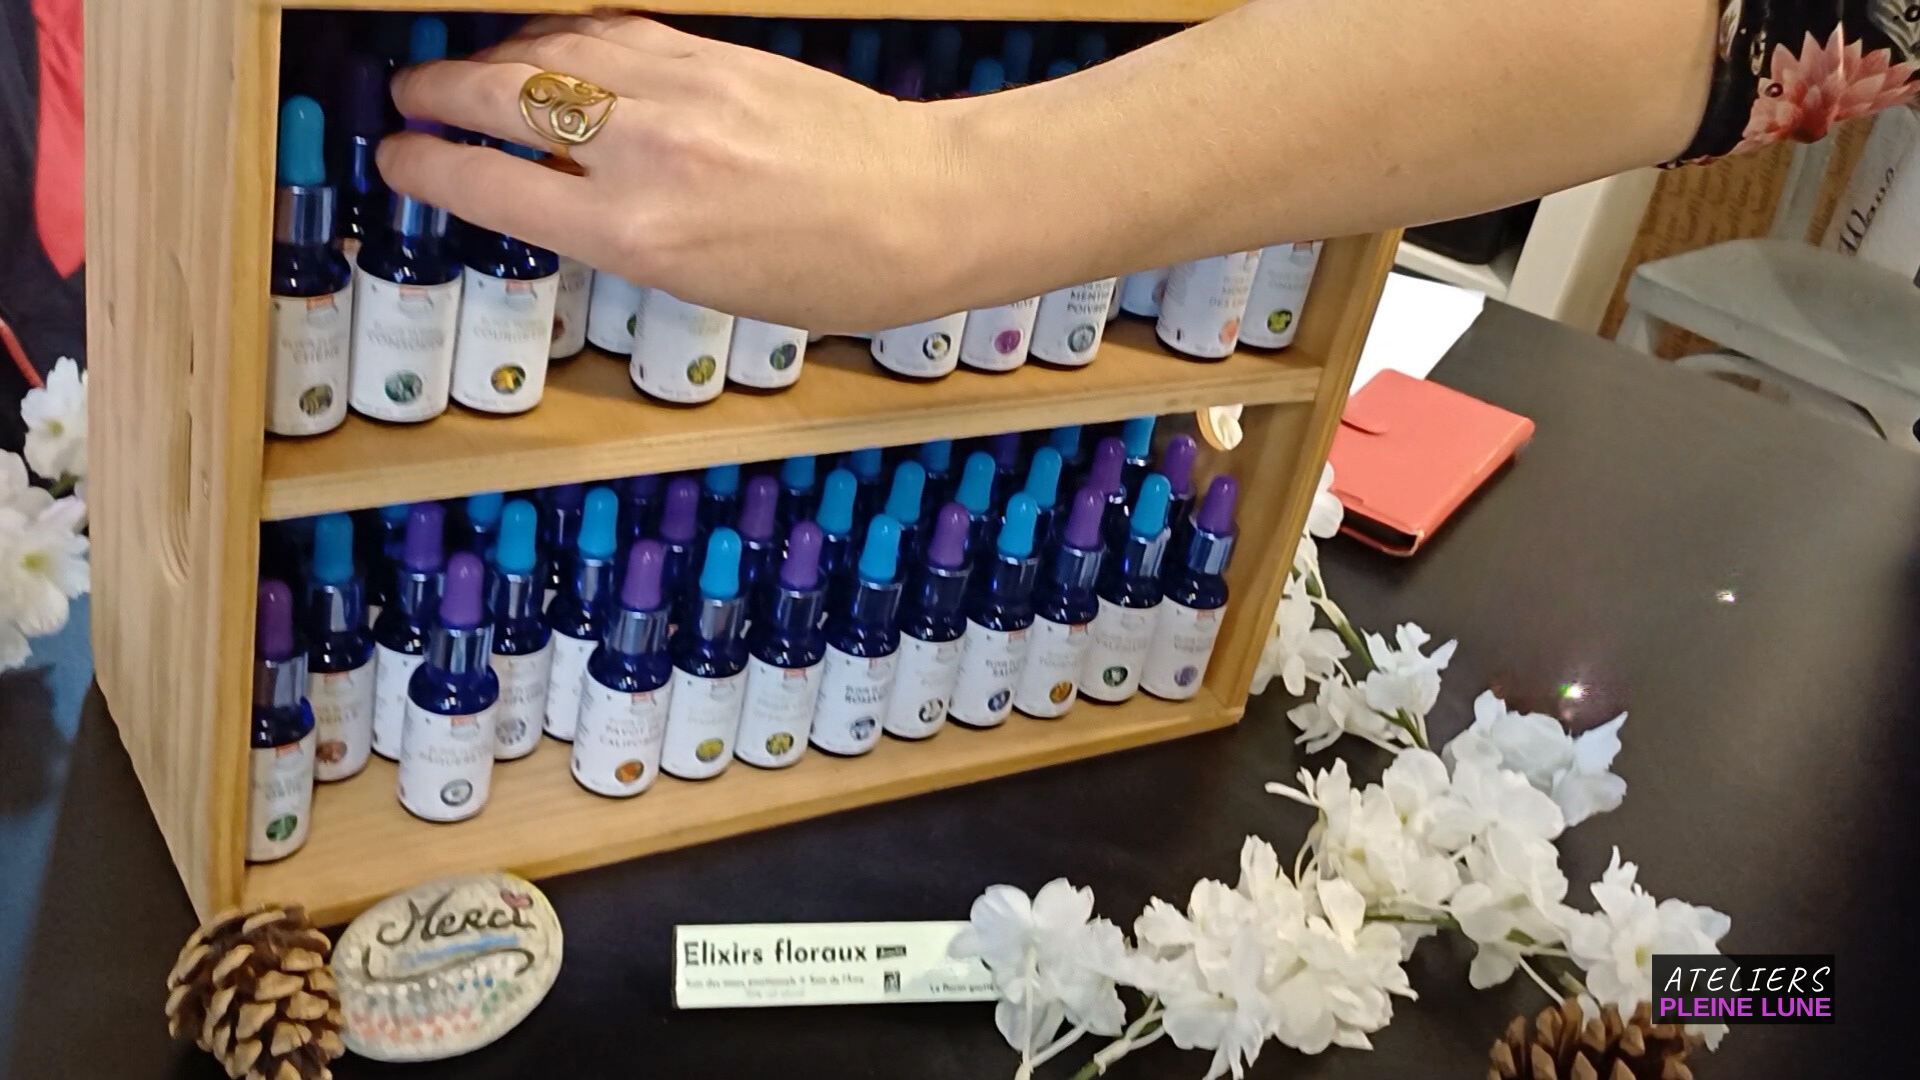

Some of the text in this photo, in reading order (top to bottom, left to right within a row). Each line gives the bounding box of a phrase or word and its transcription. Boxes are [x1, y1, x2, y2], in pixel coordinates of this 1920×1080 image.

[376, 887, 536, 946] Merci
[683, 939, 763, 967] Elixirs
[775, 937, 867, 964] floraux
